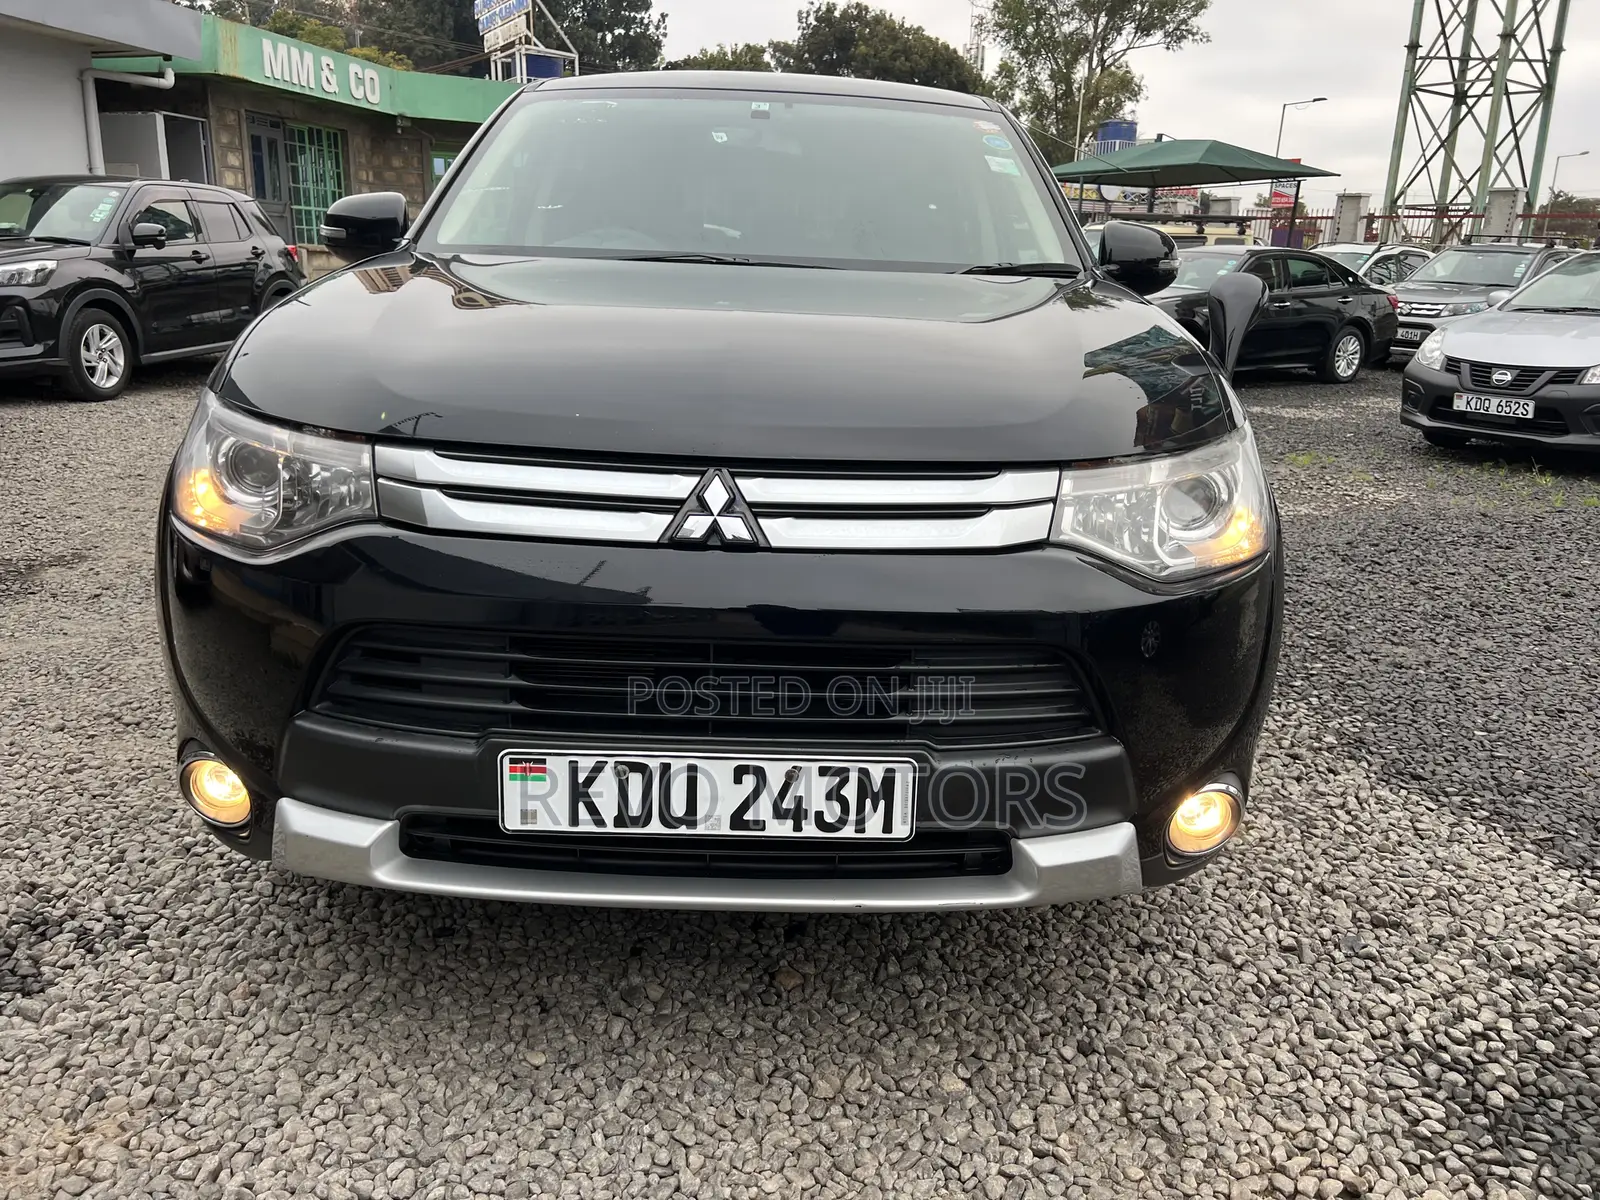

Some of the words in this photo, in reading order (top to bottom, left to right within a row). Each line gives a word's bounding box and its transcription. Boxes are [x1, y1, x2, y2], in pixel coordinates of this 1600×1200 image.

[262, 38, 315, 90] MM
[321, 55, 339, 95] &
[349, 63, 380, 105] CO
[1465, 396, 1491, 413] KDQ
[1496, 399, 1530, 417] 652S
[568, 760, 699, 830] KDU
[729, 764, 897, 835] 243M
